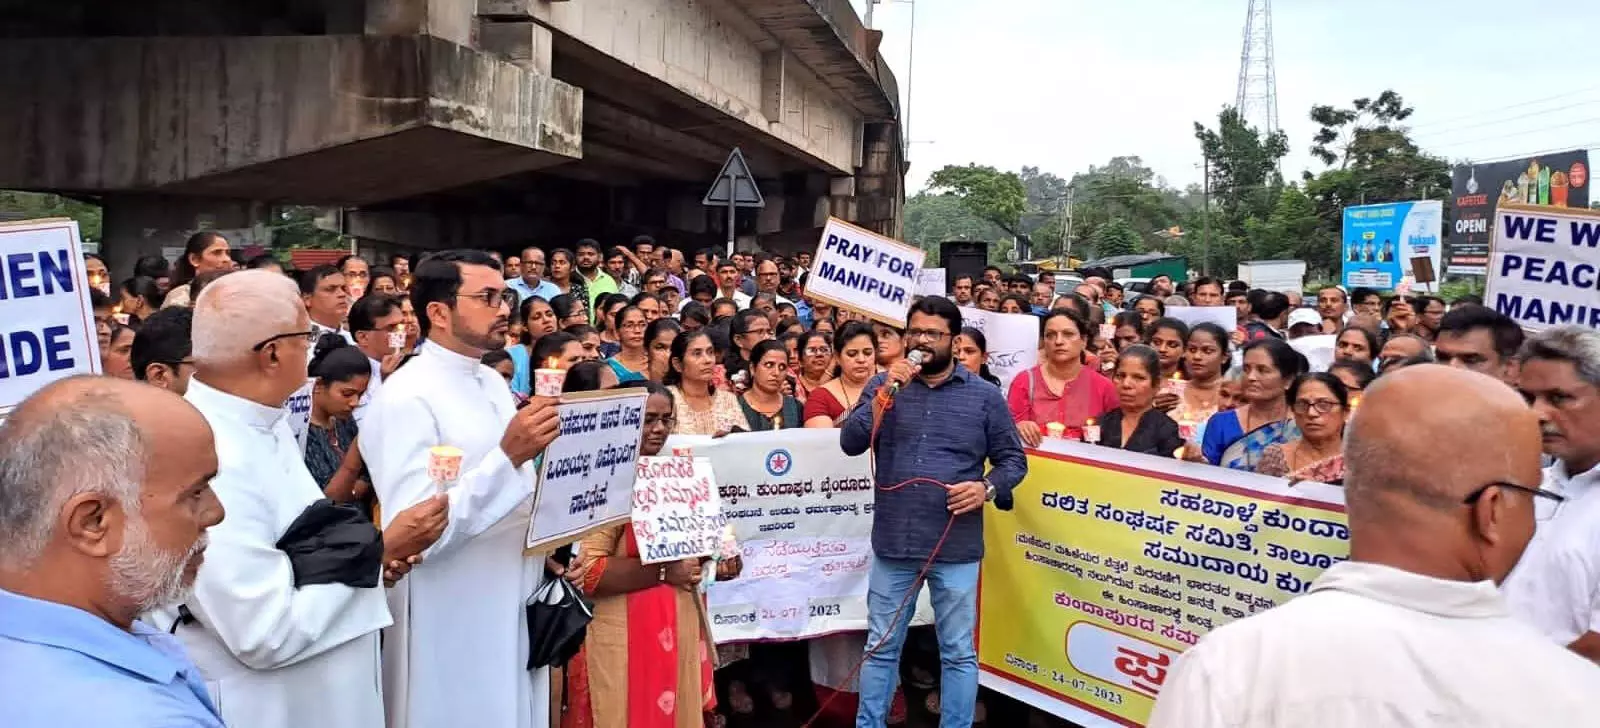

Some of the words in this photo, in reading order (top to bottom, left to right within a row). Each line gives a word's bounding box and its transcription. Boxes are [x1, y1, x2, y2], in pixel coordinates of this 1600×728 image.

[1455, 218, 1487, 233] OPEN!
[1504, 215, 1557, 243] WE
[825, 234, 874, 263] PRAY
[877, 252, 915, 279] FOR
[1501, 254, 1600, 291] PEAC
[818, 261, 906, 305] MANIPUR
[1041, 491, 1089, 516] ದಲಿತ
[1095, 503, 1180, 536] ಸಂಘರ್ಷ
[1143, 541, 1269, 585] ಸಮುದಾಯ
[809, 604, 841, 617] 2023
[1052, 670, 1123, 705] 24-07-2023
